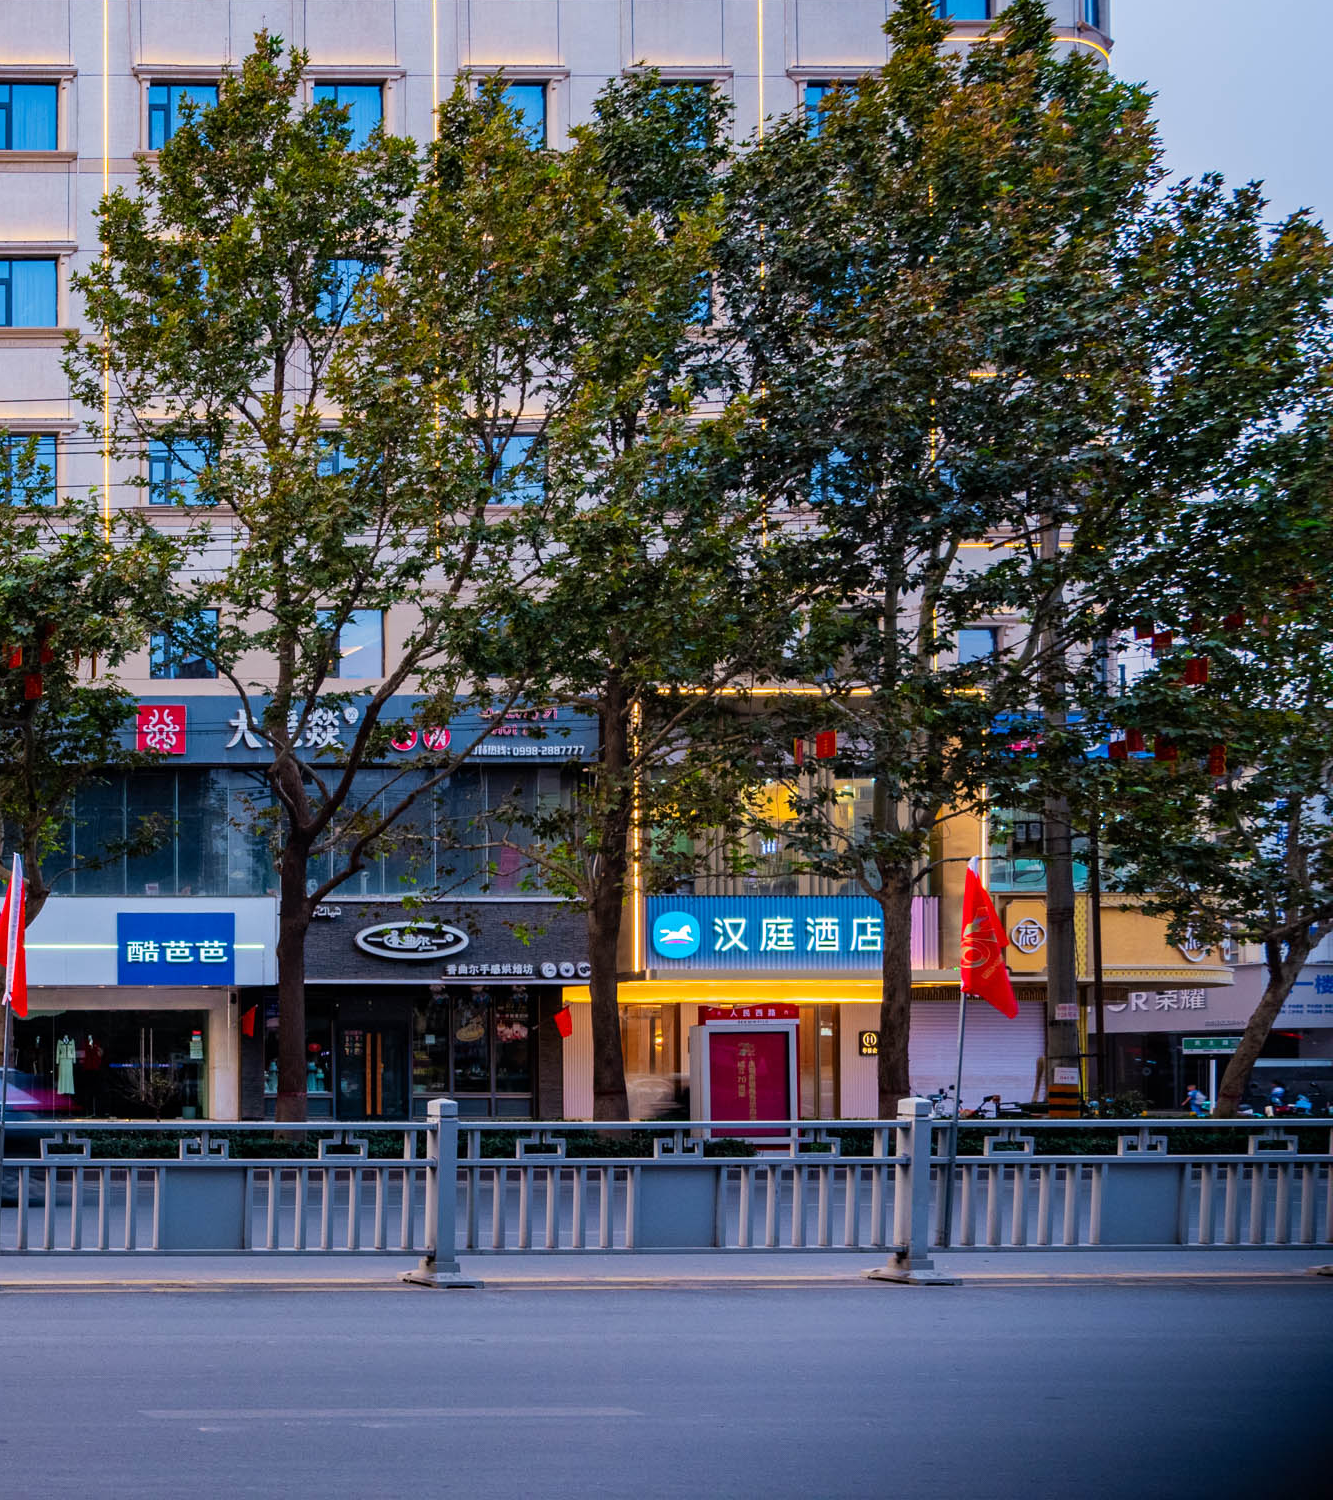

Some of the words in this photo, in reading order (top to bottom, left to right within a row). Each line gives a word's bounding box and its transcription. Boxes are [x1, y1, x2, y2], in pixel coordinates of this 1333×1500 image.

[513, 745, 585, 757] 0998-2887777
[714, 916, 881, 952] 汉庭酒店
[126, 940, 228, 963] 酷芭芭
[1155, 989, 1206, 1010] 荣耀
